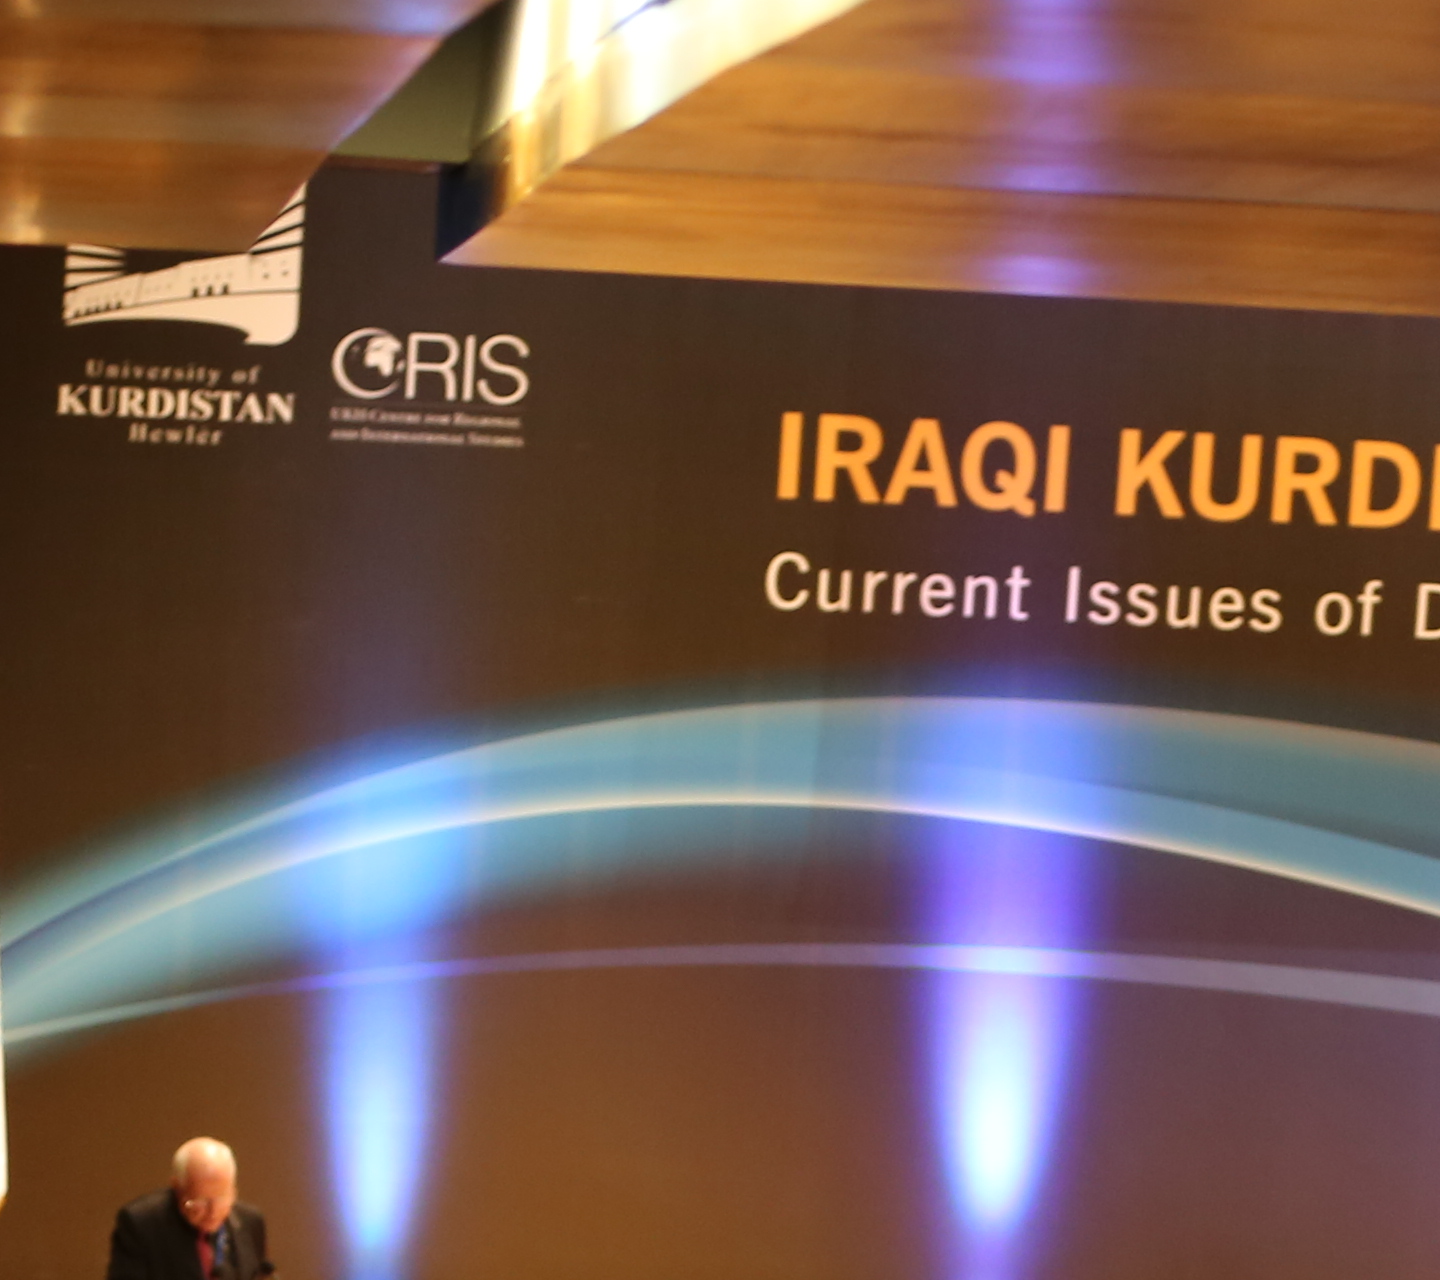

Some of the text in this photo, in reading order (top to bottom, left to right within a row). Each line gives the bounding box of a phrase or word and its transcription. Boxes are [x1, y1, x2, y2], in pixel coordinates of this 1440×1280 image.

[57, 383, 296, 424] KURDISTAN
[85, 358, 262, 386] University of
[331, 326, 530, 406] CRIS
[776, 411, 1071, 518] IRAQI
[765, 551, 1031, 622] Current
[1065, 566, 1283, 633] Issues
[1314, 580, 1383, 637] of
